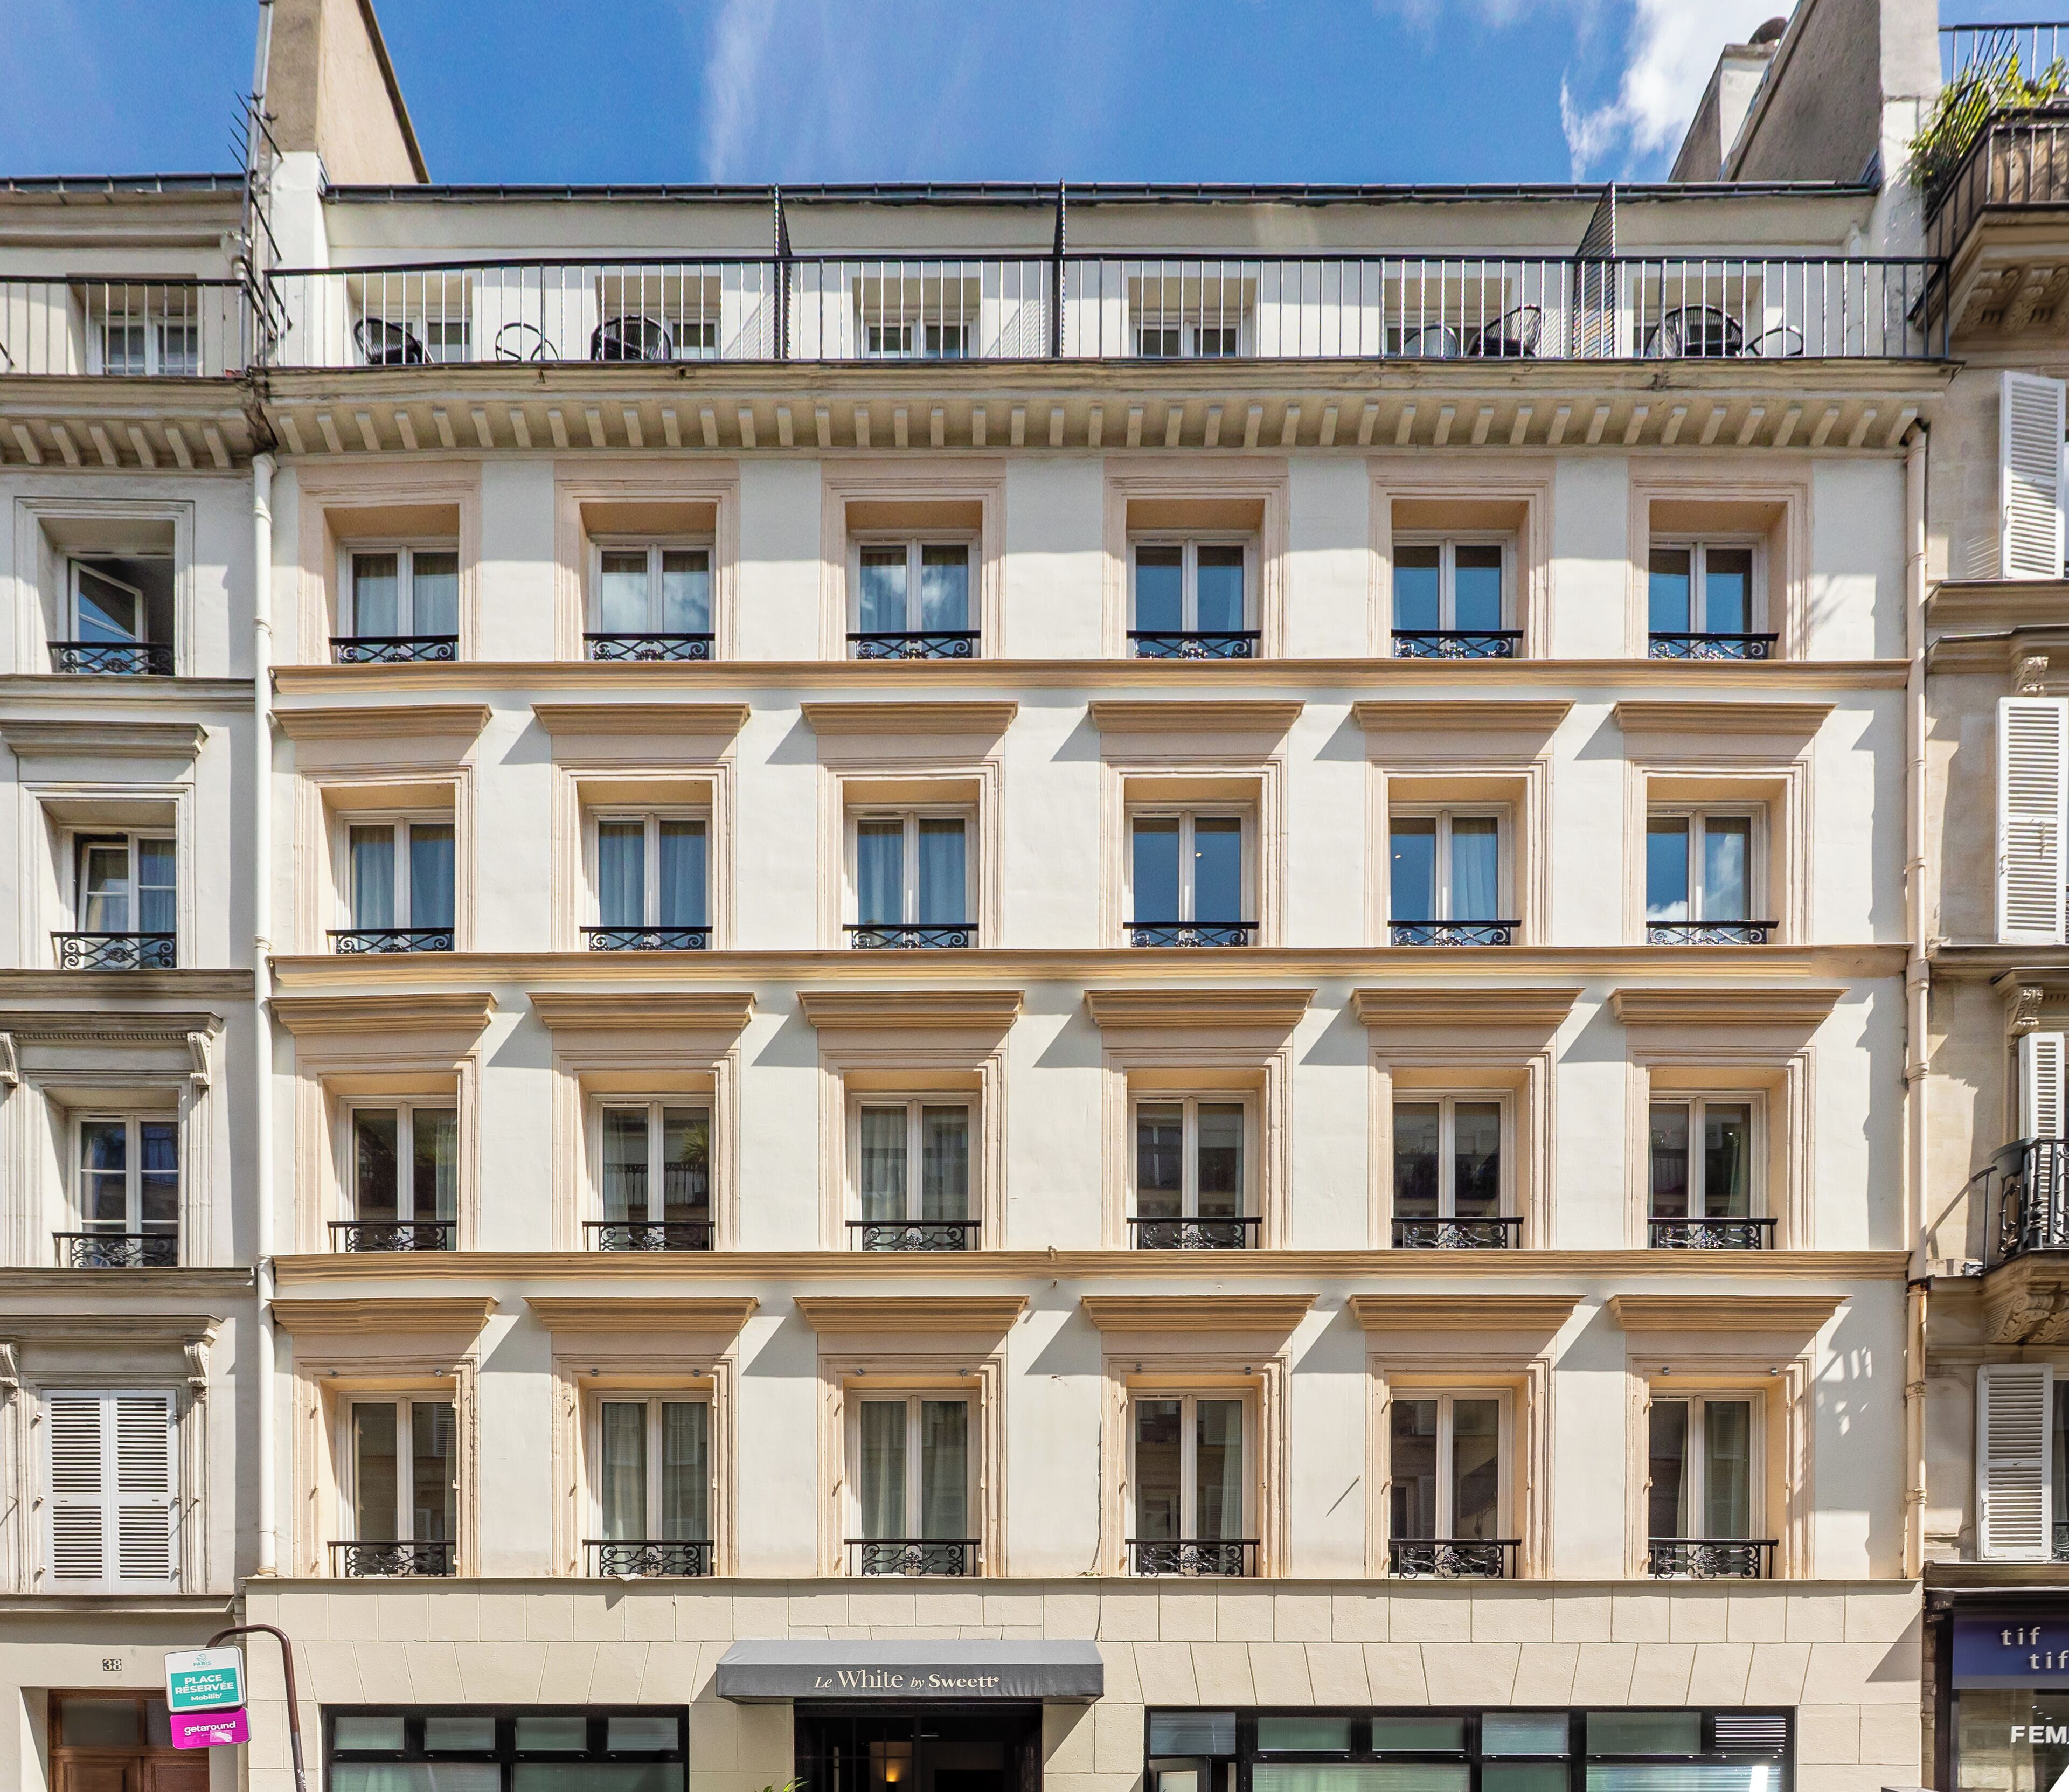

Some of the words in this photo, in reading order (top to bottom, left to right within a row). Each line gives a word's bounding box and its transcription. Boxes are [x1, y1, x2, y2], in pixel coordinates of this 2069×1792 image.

[2001, 1627, 2041, 1645] tif
[103, 1659, 122, 1671] 38
[2029, 1650, 2069, 1669] tif
[175, 1681, 234, 1694] RÉSERVÉE
[184, 1674, 223, 1685] PLACE
[814, 1676, 832, 1689] Le
[837, 1669, 904, 1688] White
[910, 1677, 924, 1690] by
[184, 1721, 236, 1736] getaround
[2011, 1725, 2069, 1744] FEM
